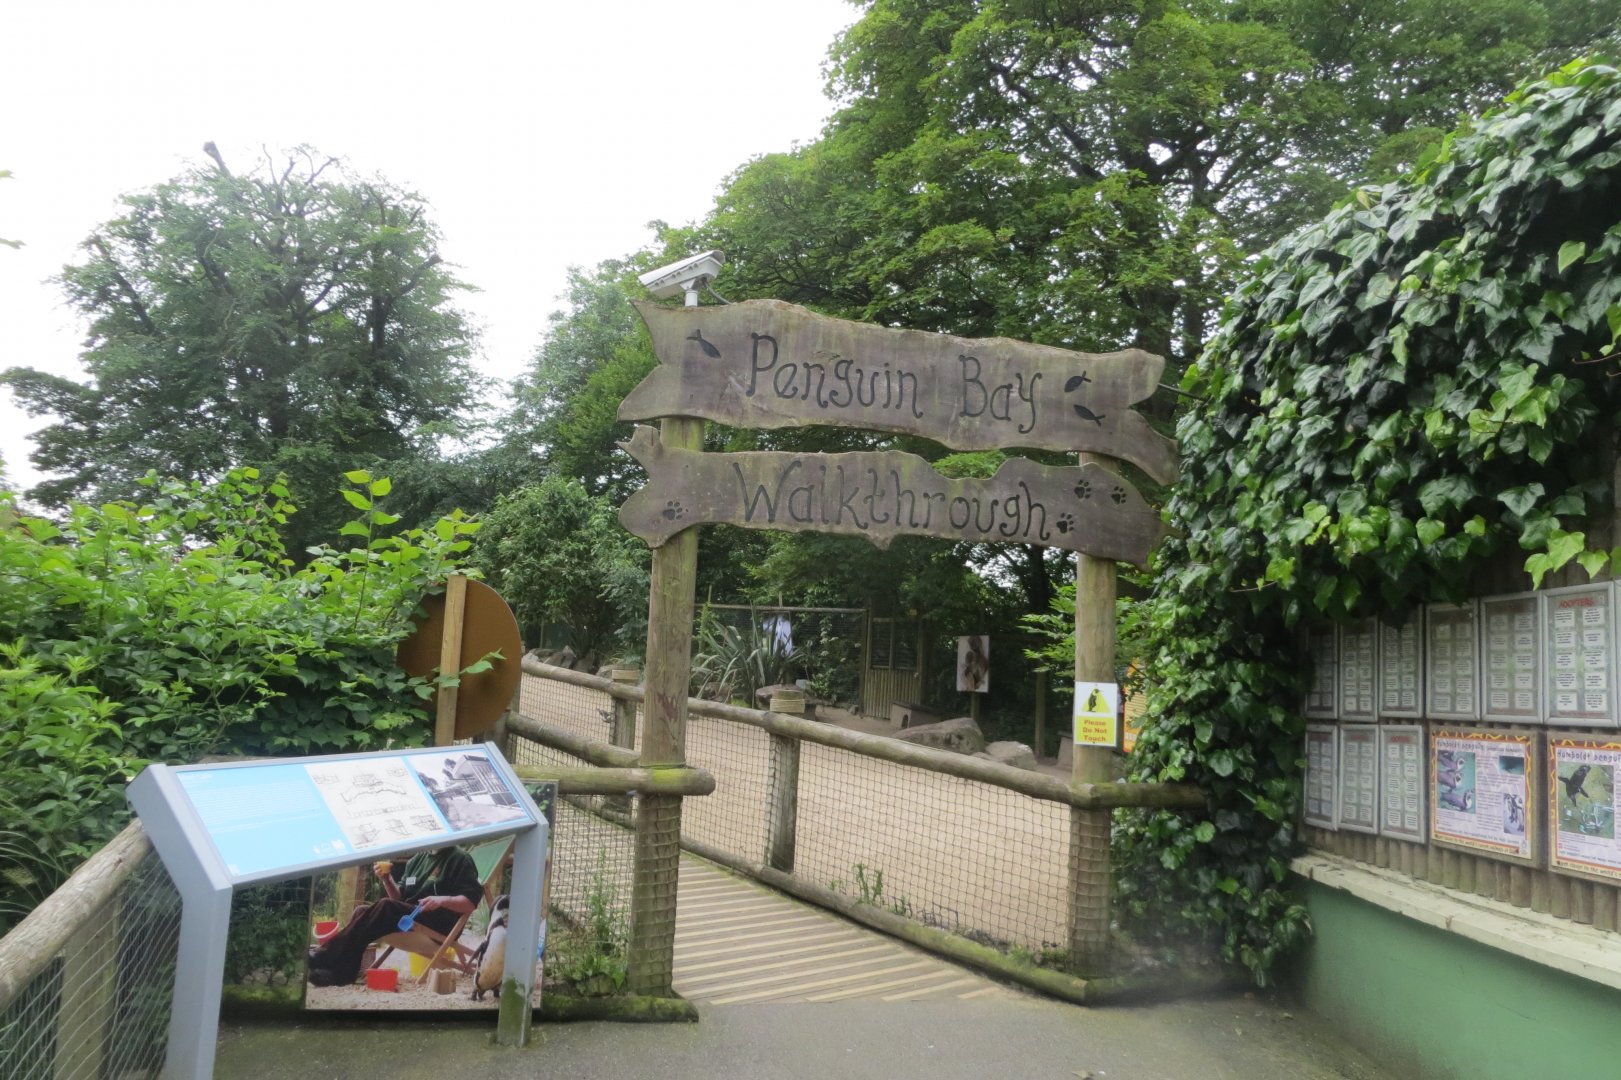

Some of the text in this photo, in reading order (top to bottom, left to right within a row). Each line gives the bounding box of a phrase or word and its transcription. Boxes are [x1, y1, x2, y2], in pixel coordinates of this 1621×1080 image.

[746, 332, 1042, 434] Penguin Bay
[732, 460, 1050, 541] Walkthrough
